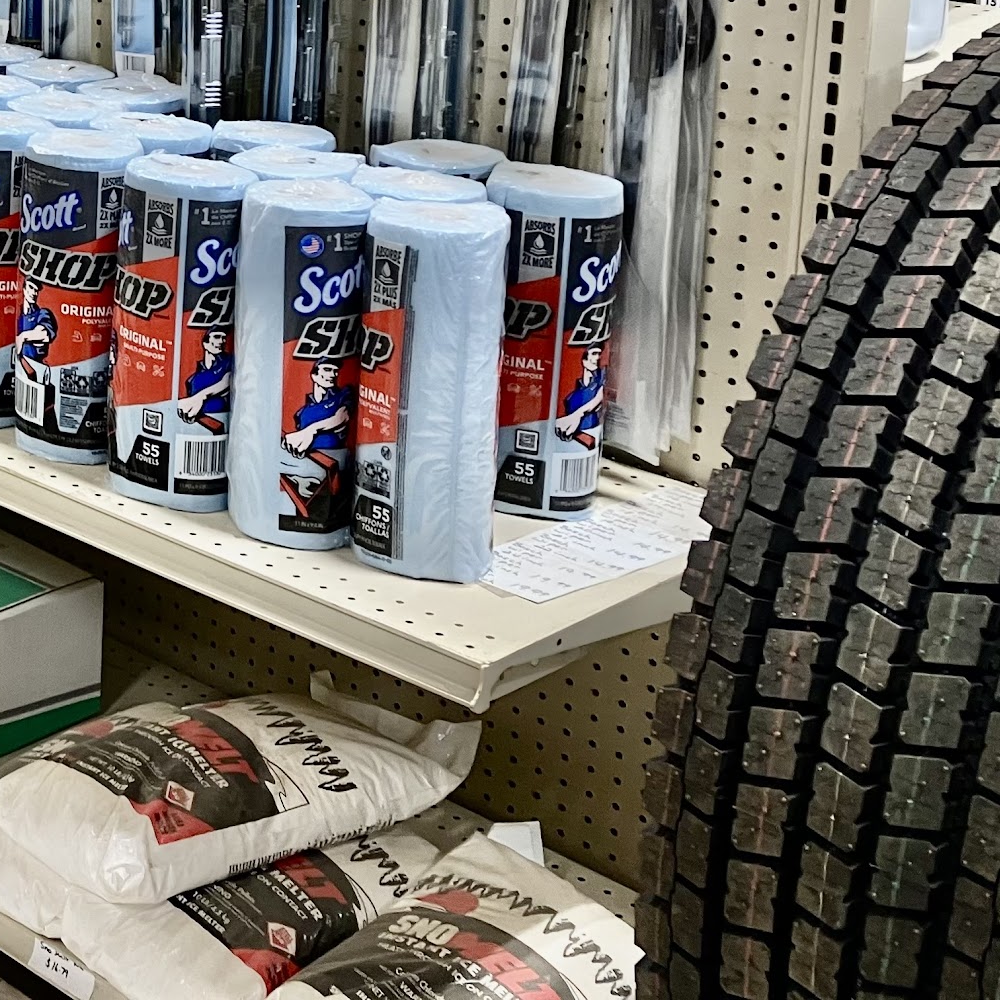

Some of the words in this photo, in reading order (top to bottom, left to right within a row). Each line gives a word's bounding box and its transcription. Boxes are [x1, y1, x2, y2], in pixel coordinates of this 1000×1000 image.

[21, 192, 78, 233] Scott
[147, 198, 173, 215] ABSORBS
[525, 218, 557, 234] ABSORBS
[153, 236, 173, 249] MORE
[326, 231, 343, 252] #1
[18, 240, 117, 291] SHOP
[522, 255, 532, 266] 2X
[532, 256, 555, 269] MORE
[373, 283, 384, 296] 2X
[384, 285, 398, 299] PLUS
[61, 303, 114, 316] ORIGINA
[142, 443, 160, 457] 55
[135, 453, 160, 466] TOWELS
[514, 462, 535, 477] 55
[504, 472, 534, 485] TOWELS
[371, 505, 391, 522] 55
[186, 747, 230, 790] MELTER
[256, 874, 272, 887] ON
[271, 885, 309, 921] CONTACT
[269, 869, 323, 922] MELTER
[388, 914, 460, 945] SNO
